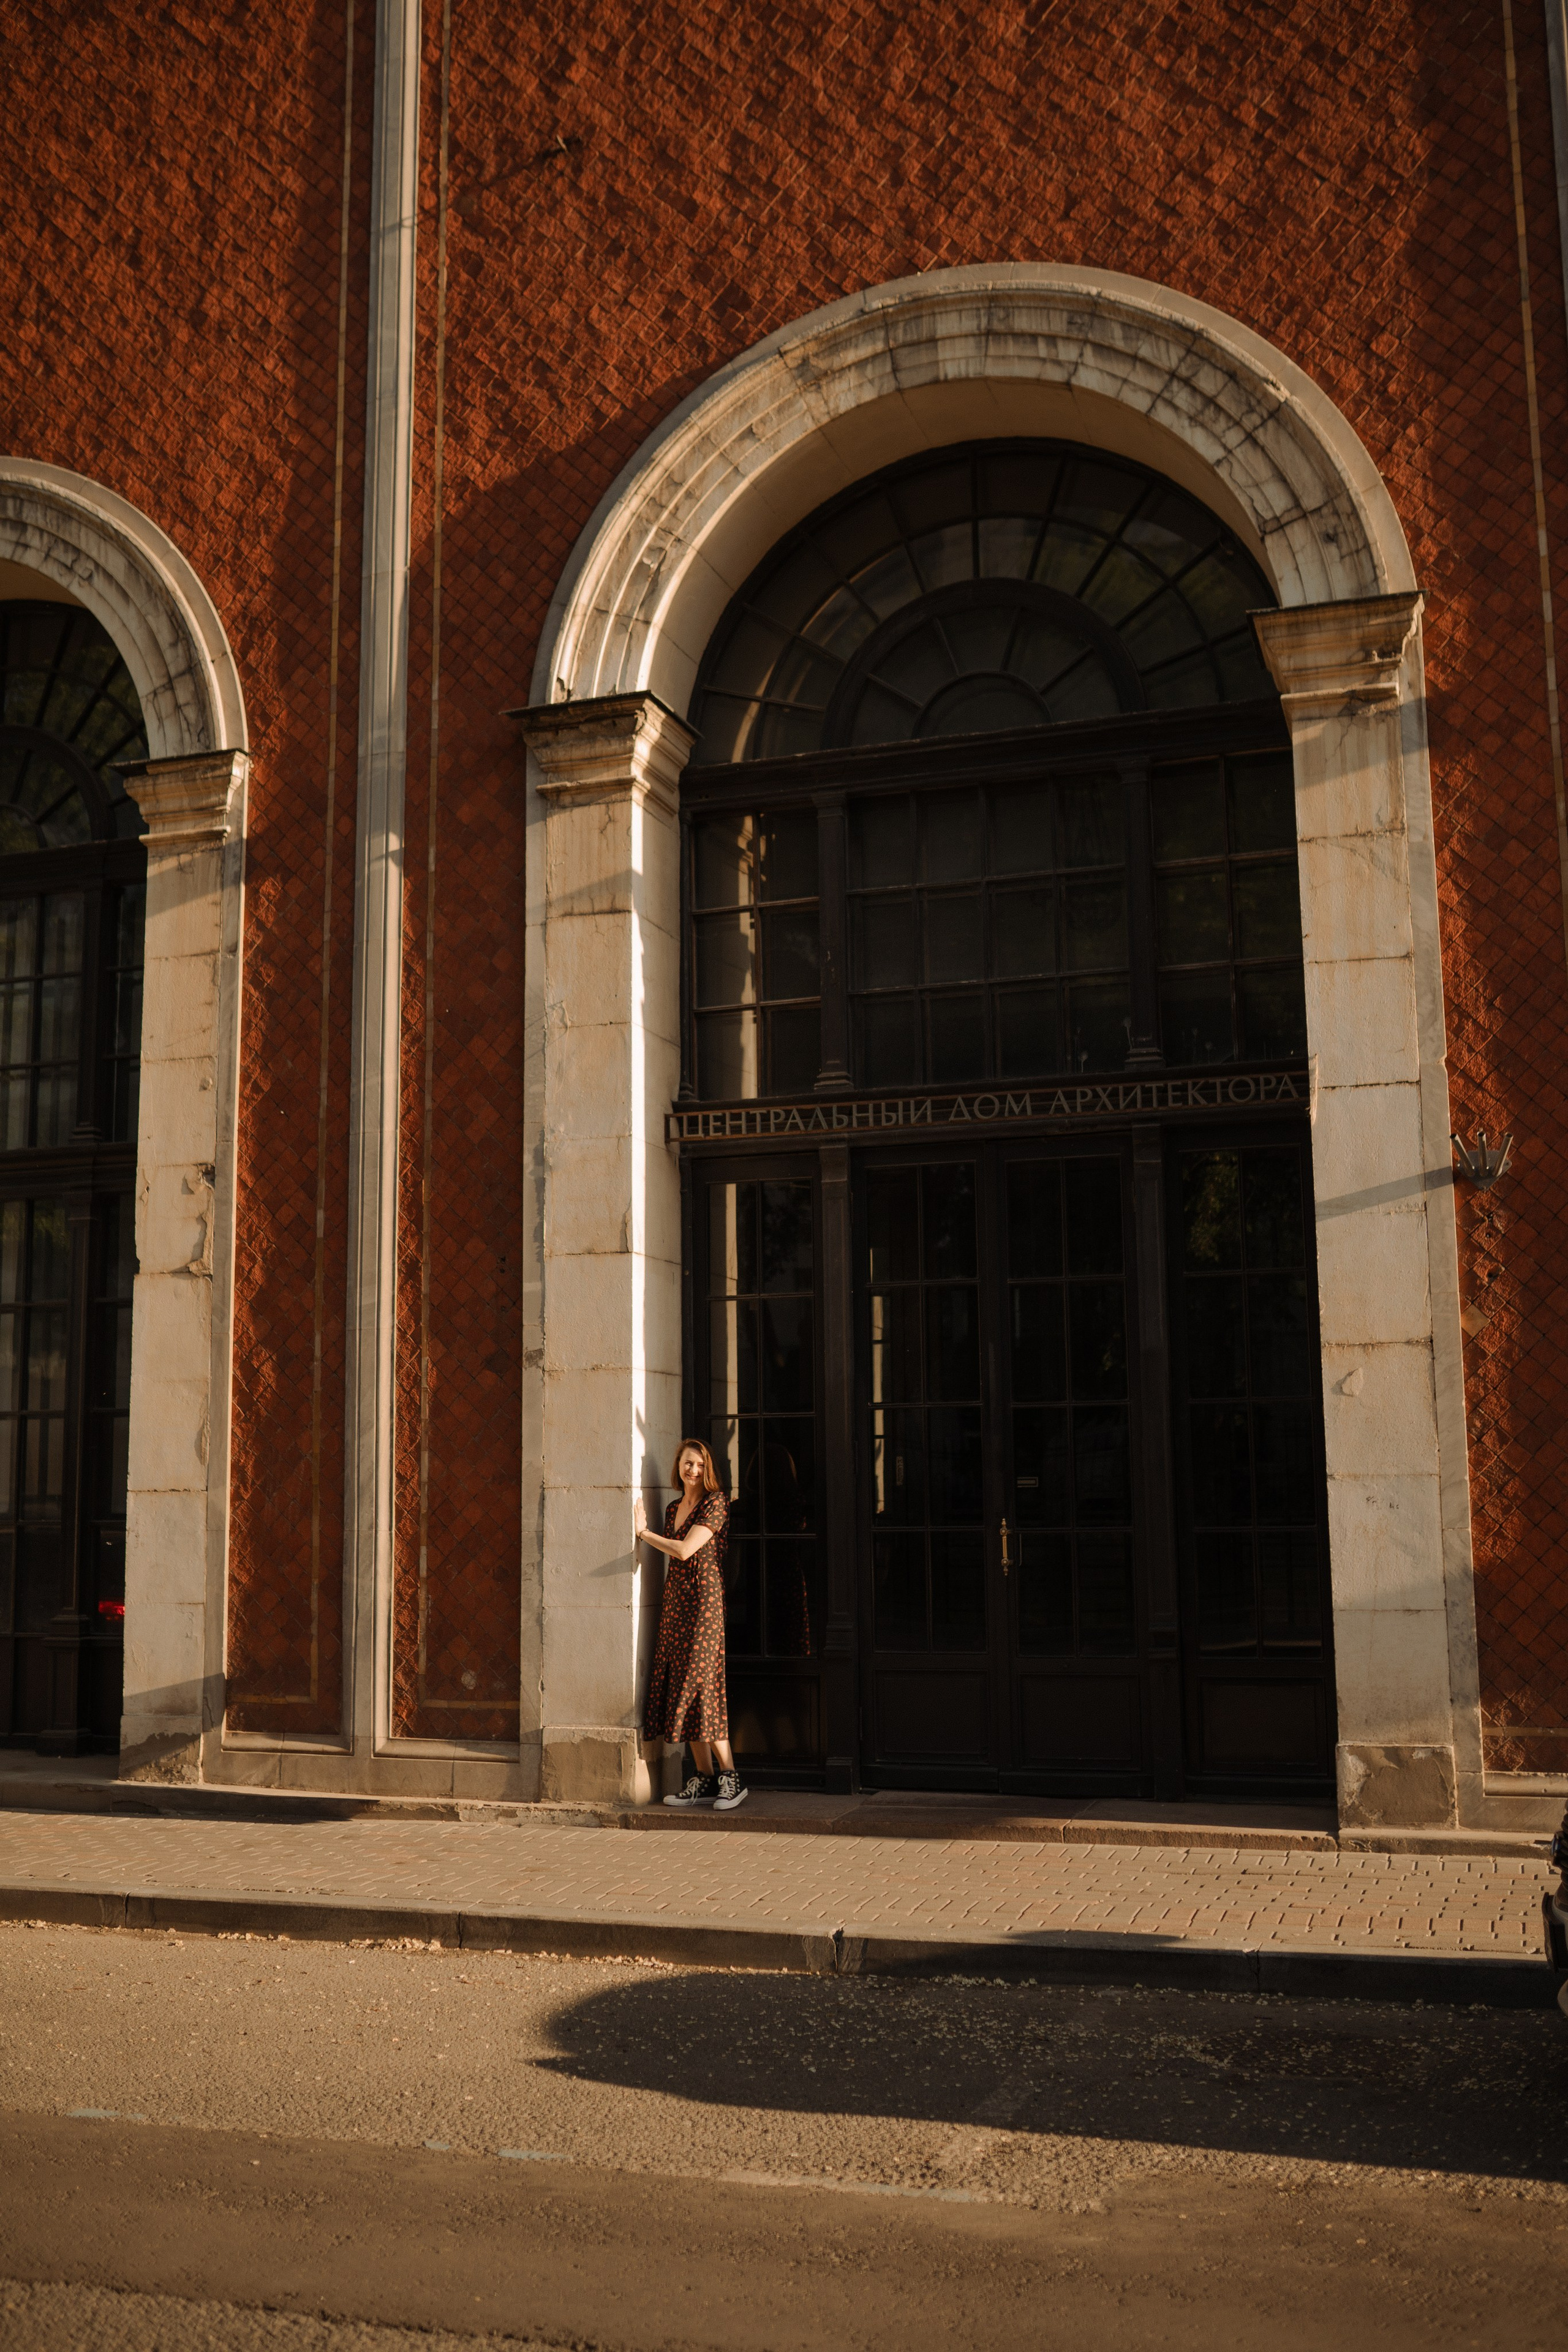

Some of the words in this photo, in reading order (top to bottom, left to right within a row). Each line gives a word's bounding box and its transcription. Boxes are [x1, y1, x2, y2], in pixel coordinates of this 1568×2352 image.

[683, 1097, 932, 1139] ЦЕНТРАЛЬНЫЙ
[948, 1091, 1033, 1121] ДОМ
[1048, 1074, 1299, 1115] АРХИТЕКТОРА
